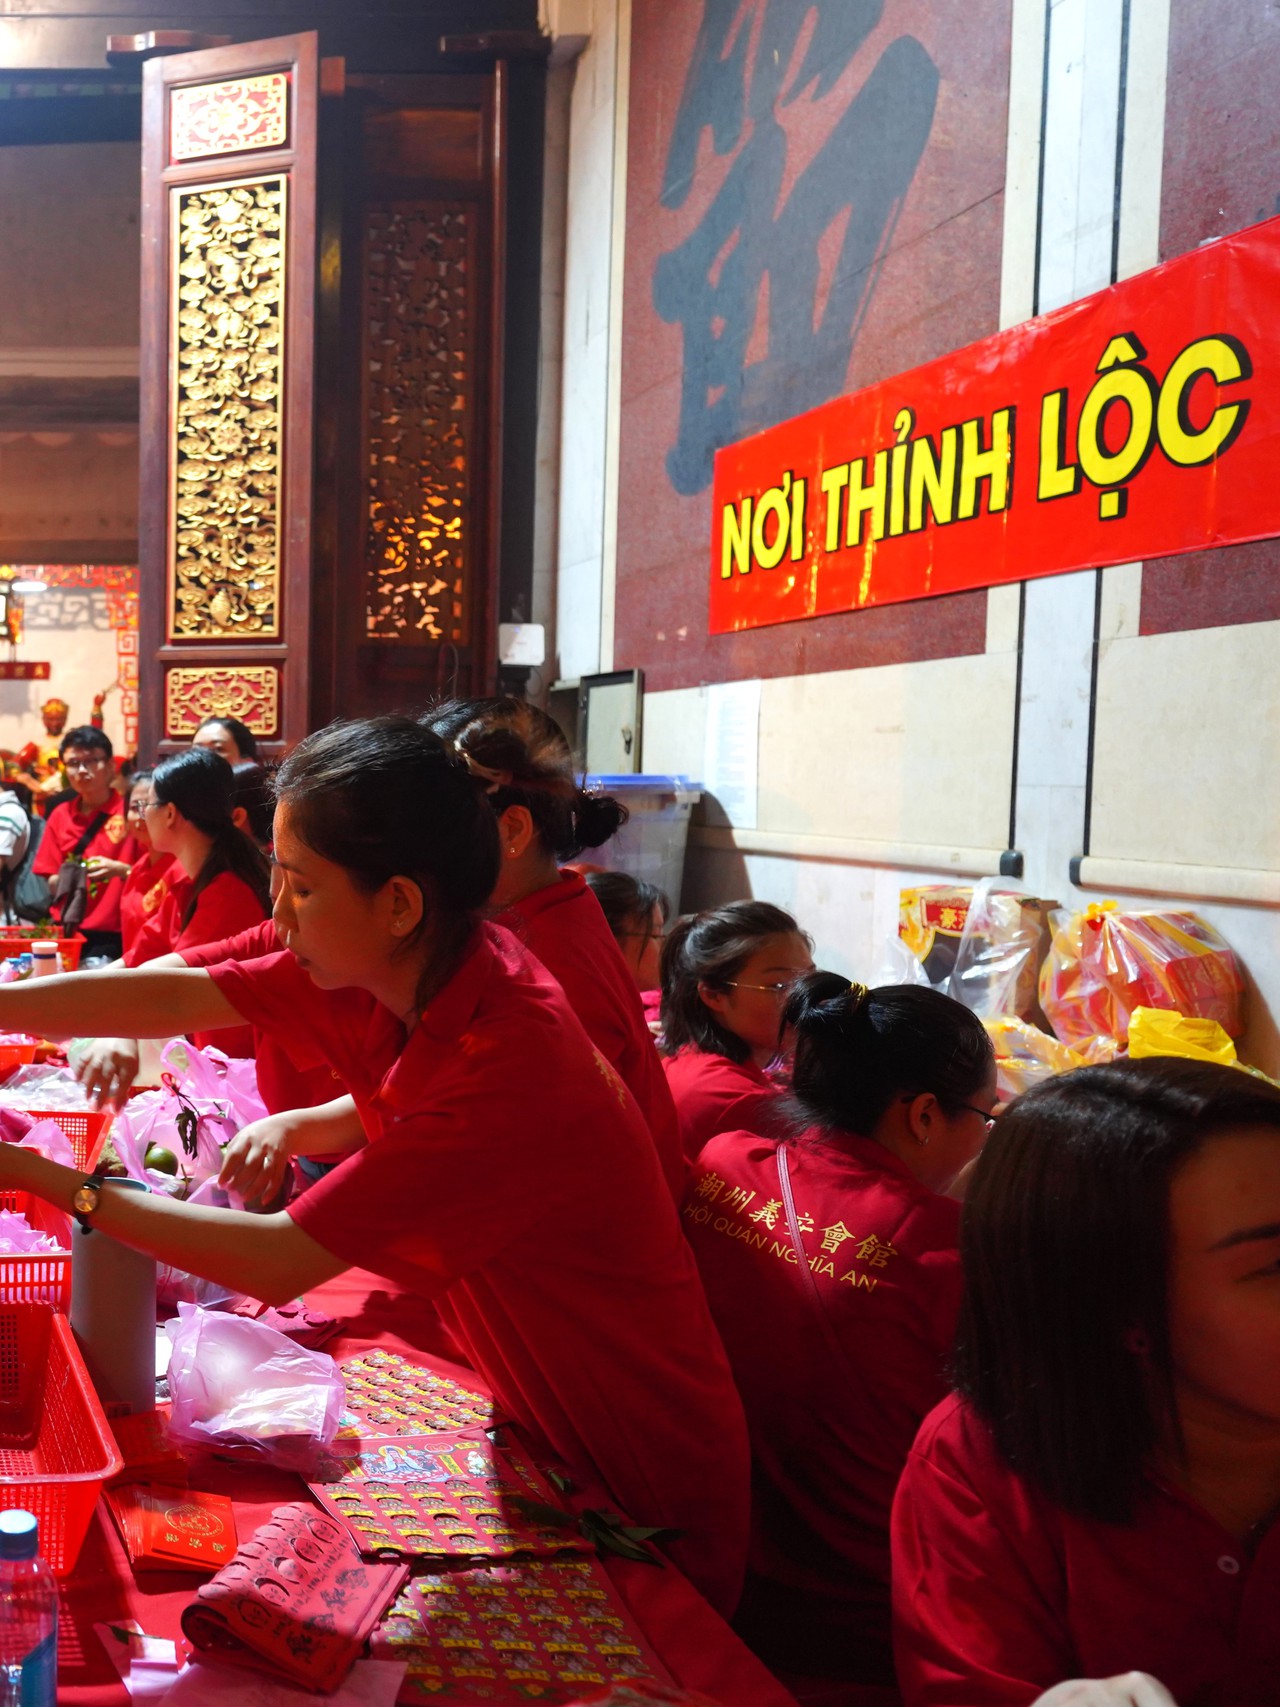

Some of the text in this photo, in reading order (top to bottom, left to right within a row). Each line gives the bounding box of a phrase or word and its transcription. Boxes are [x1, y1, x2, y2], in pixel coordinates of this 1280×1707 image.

[720, 331, 1253, 580] NƠI THỈNH LỘC
[683, 1203, 878, 1294] HỘI QUÁN NGHĨA AN
[694, 1172, 899, 1269] 潮州義安會館
